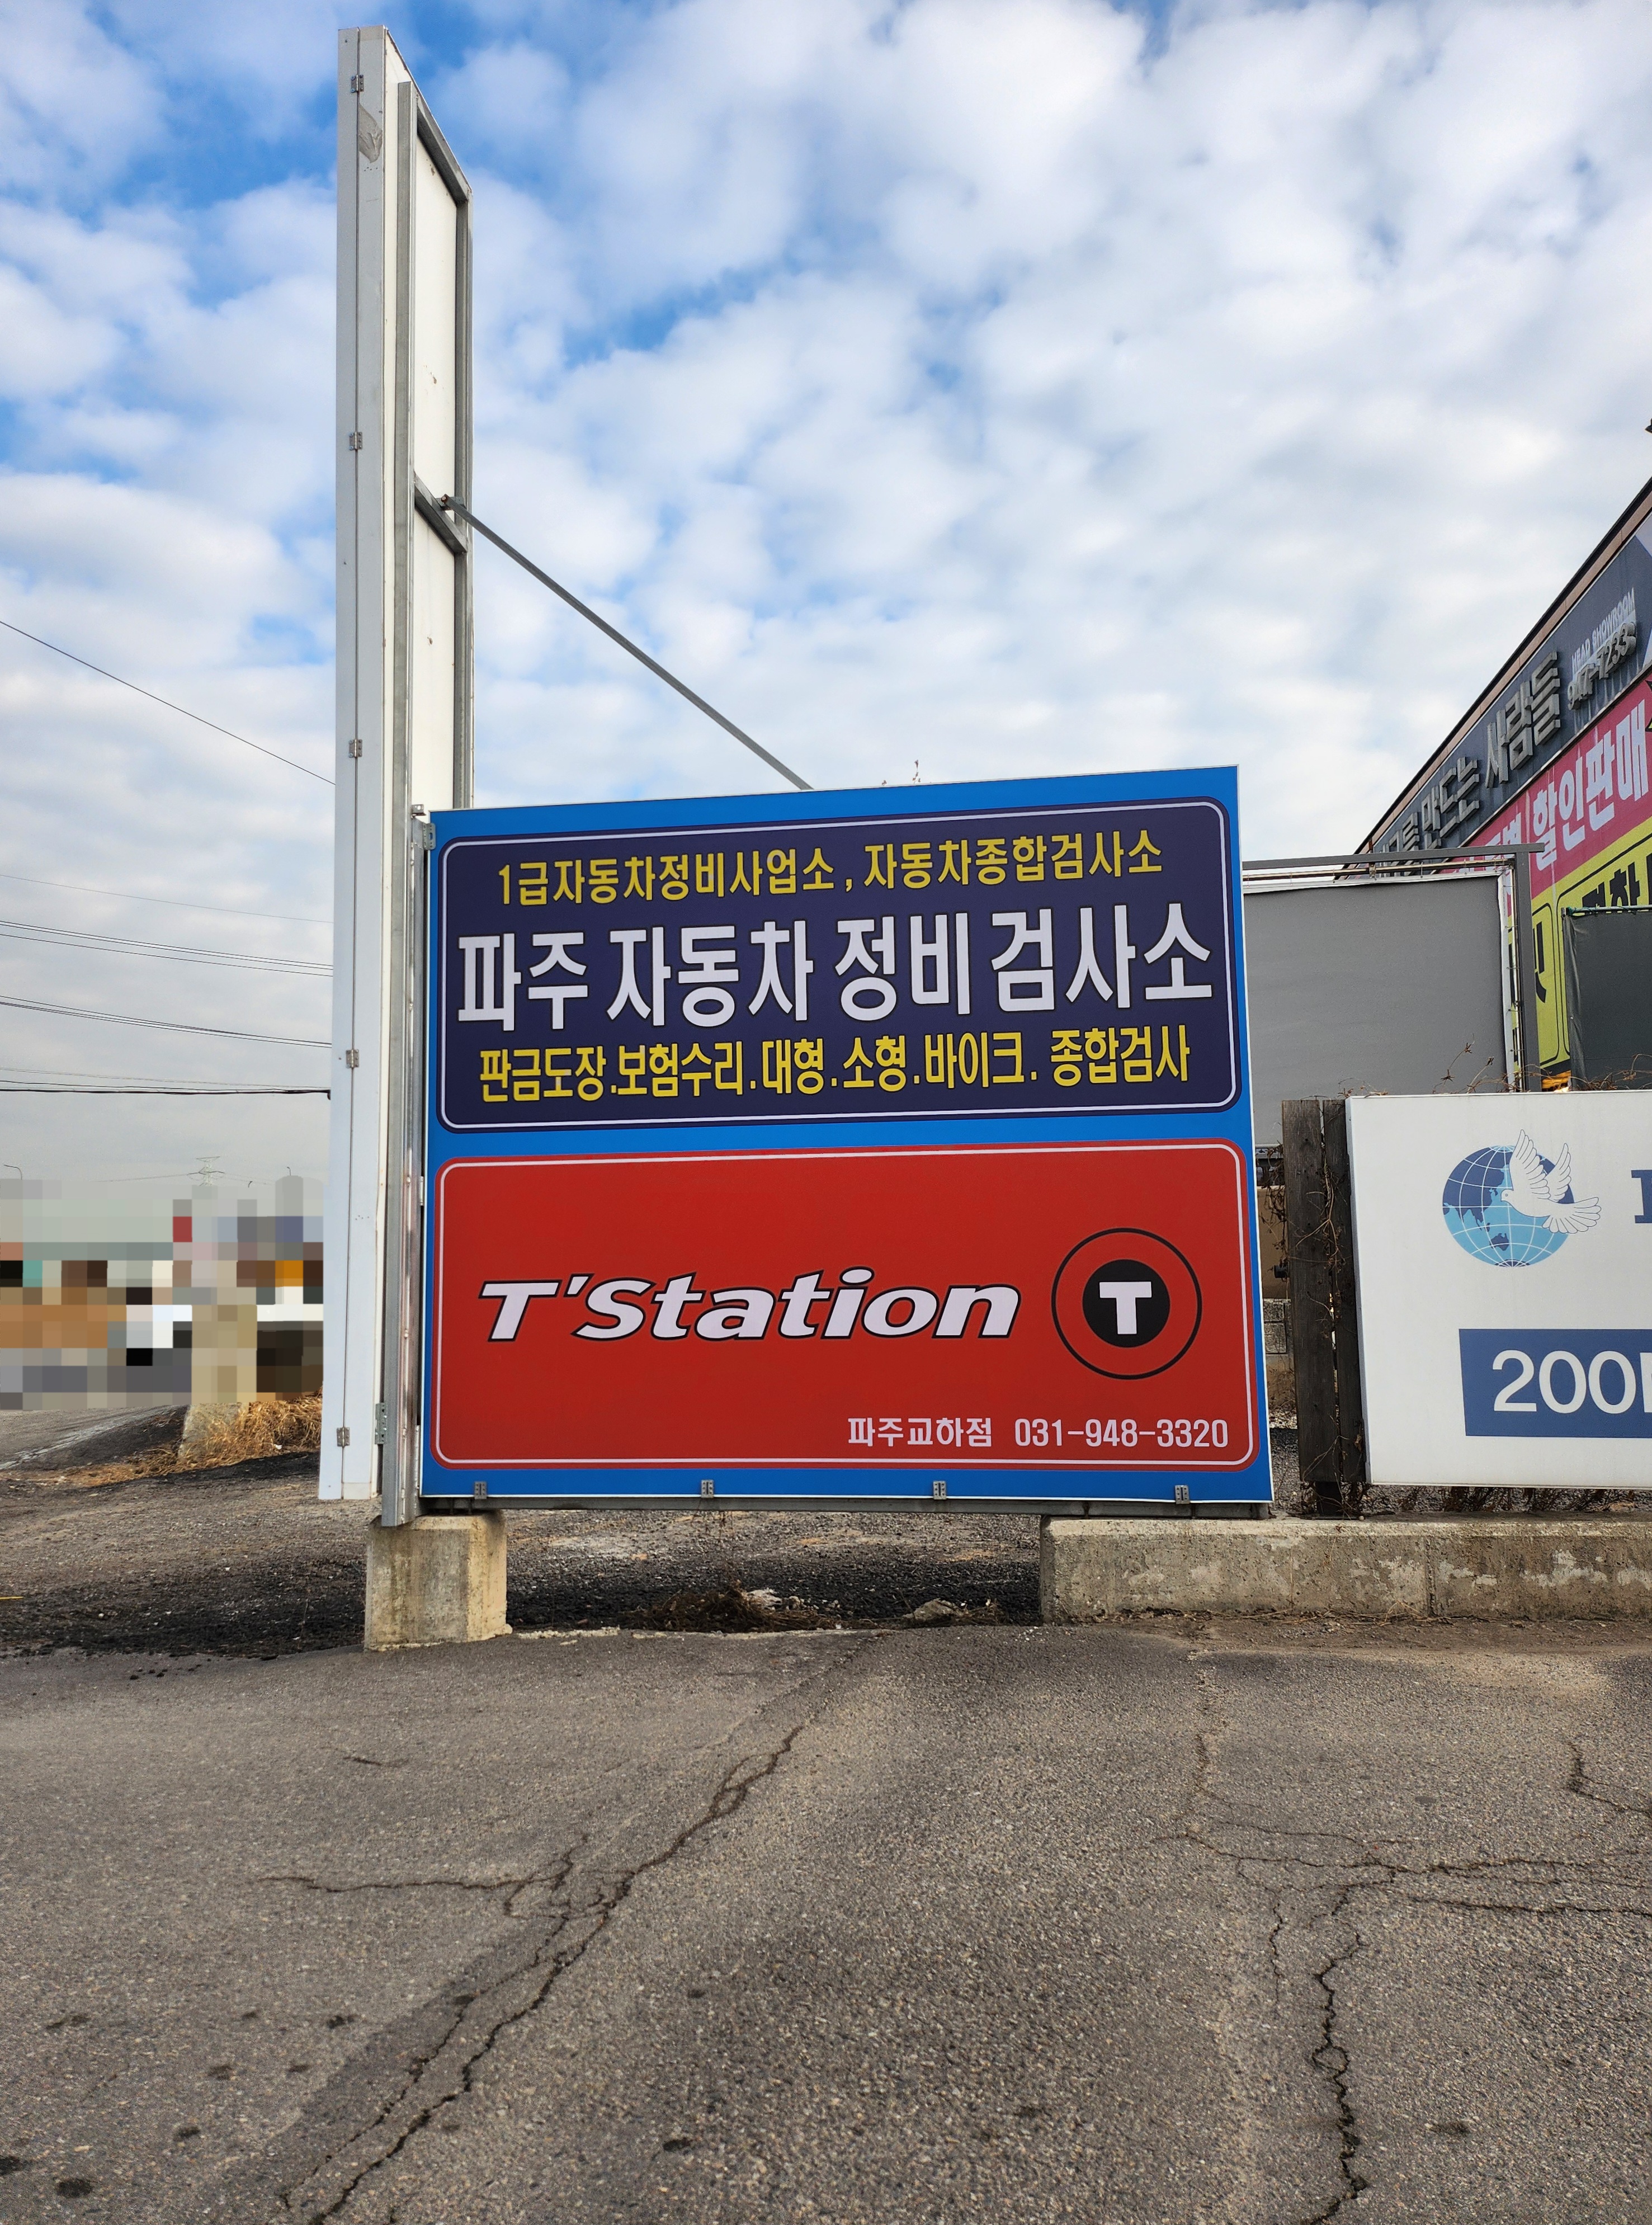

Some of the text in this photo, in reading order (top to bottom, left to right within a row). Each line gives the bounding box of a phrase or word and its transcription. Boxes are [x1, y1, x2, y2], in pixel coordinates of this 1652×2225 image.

[1485, 650, 1560, 789] 사람들
[1533, 699, 1649, 871] 할인판매
[864, 830, 1162, 889] 자동차종합검사소
[458, 903, 1212, 1031] 파주 자동차 정비 검사소
[1051, 1025, 1190, 1086] 종합검사
[479, 1266, 1152, 1341] T'Station T
[1492, 1350, 1652, 1414] 200
[848, 1417, 1228, 1449] 파주교하점 031-948-3320
